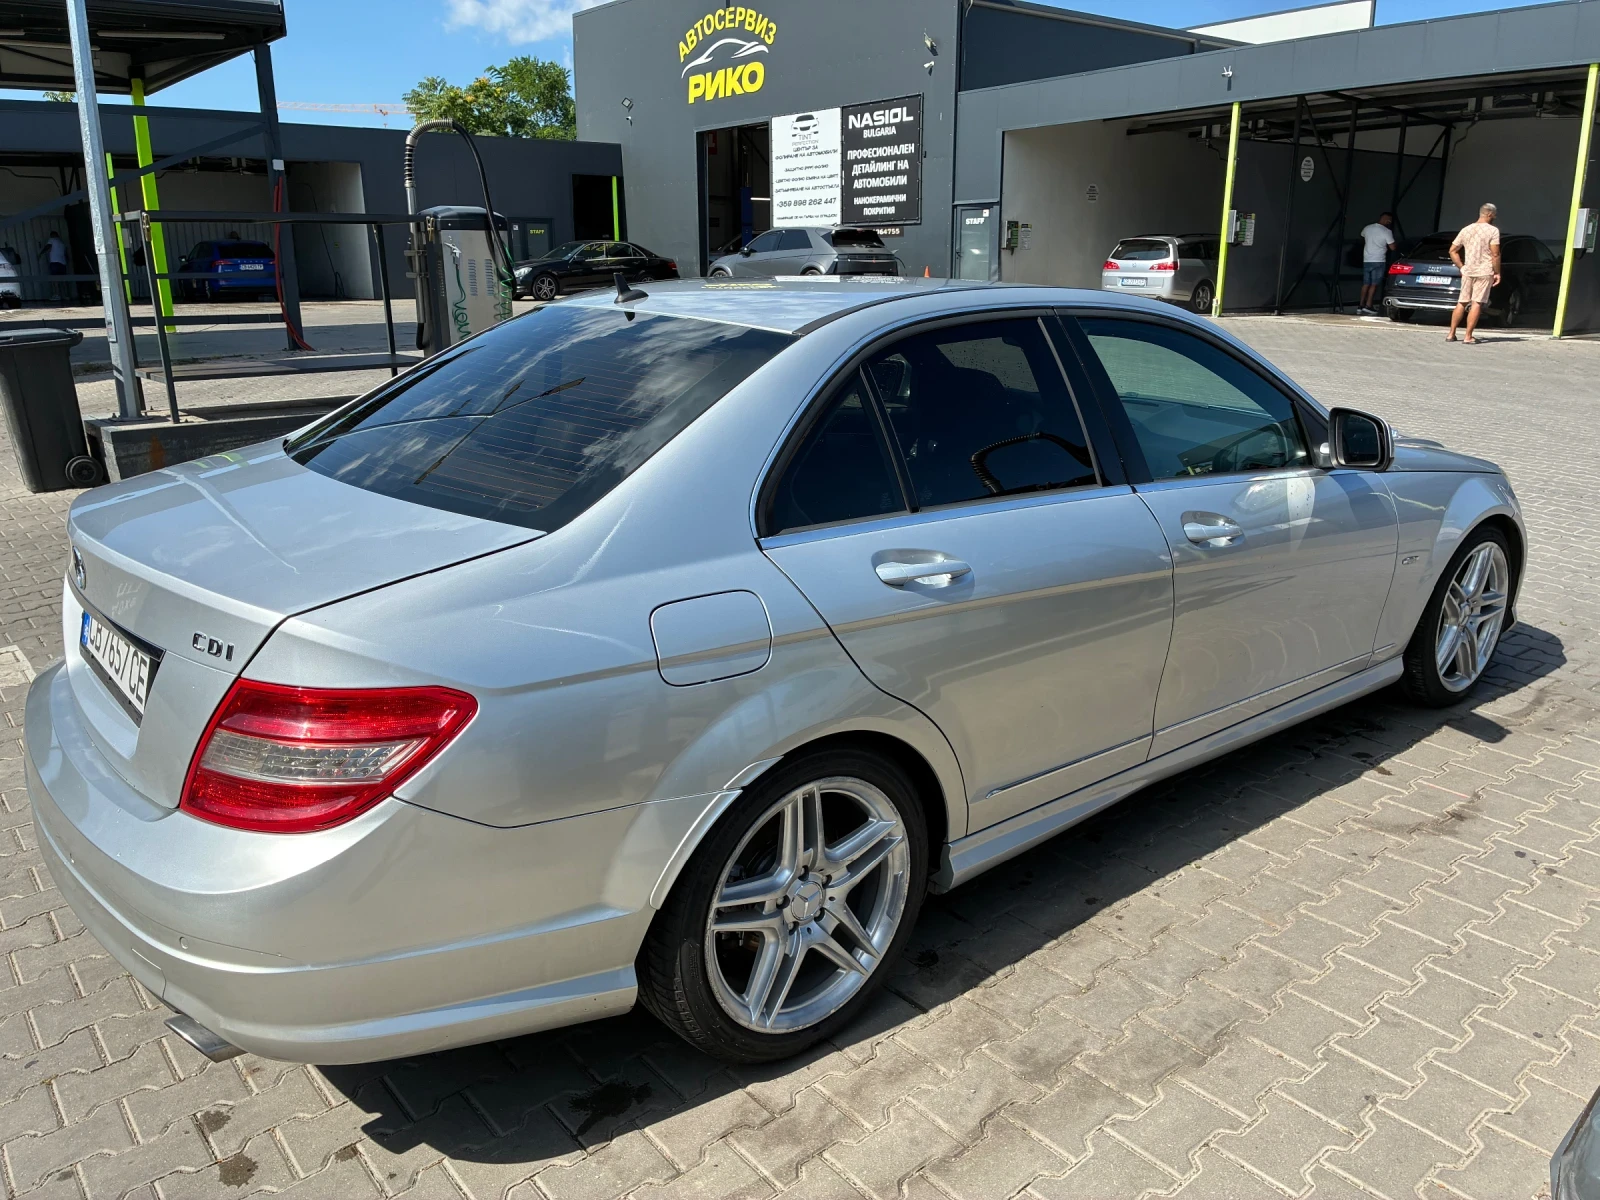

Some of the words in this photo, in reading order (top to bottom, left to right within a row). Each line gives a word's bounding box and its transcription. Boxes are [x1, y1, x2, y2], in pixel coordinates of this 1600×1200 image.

[678, 6, 777, 63] АВТОСЕРВИЗ
[688, 61, 765, 104] РИКО
[848, 106, 914, 129] NASIOL
[863, 126, 897, 138] BULGARIA
[847, 143, 915, 160] ПРОФЕСИОНАЛЕН
[852, 160, 897, 176] ДЕТАЙЛИНГ
[897, 159, 909, 170] НА
[853, 175, 908, 189] АВТОМОБИЛИ
[823, 197, 837, 205] 447
[853, 193, 907, 205] НАНОКЕРАМИЧНИ
[863, 206, 896, 216] ПОКРИТИЯ
[965, 217, 985, 225] STAFF
[191, 631, 235, 661] CDI
